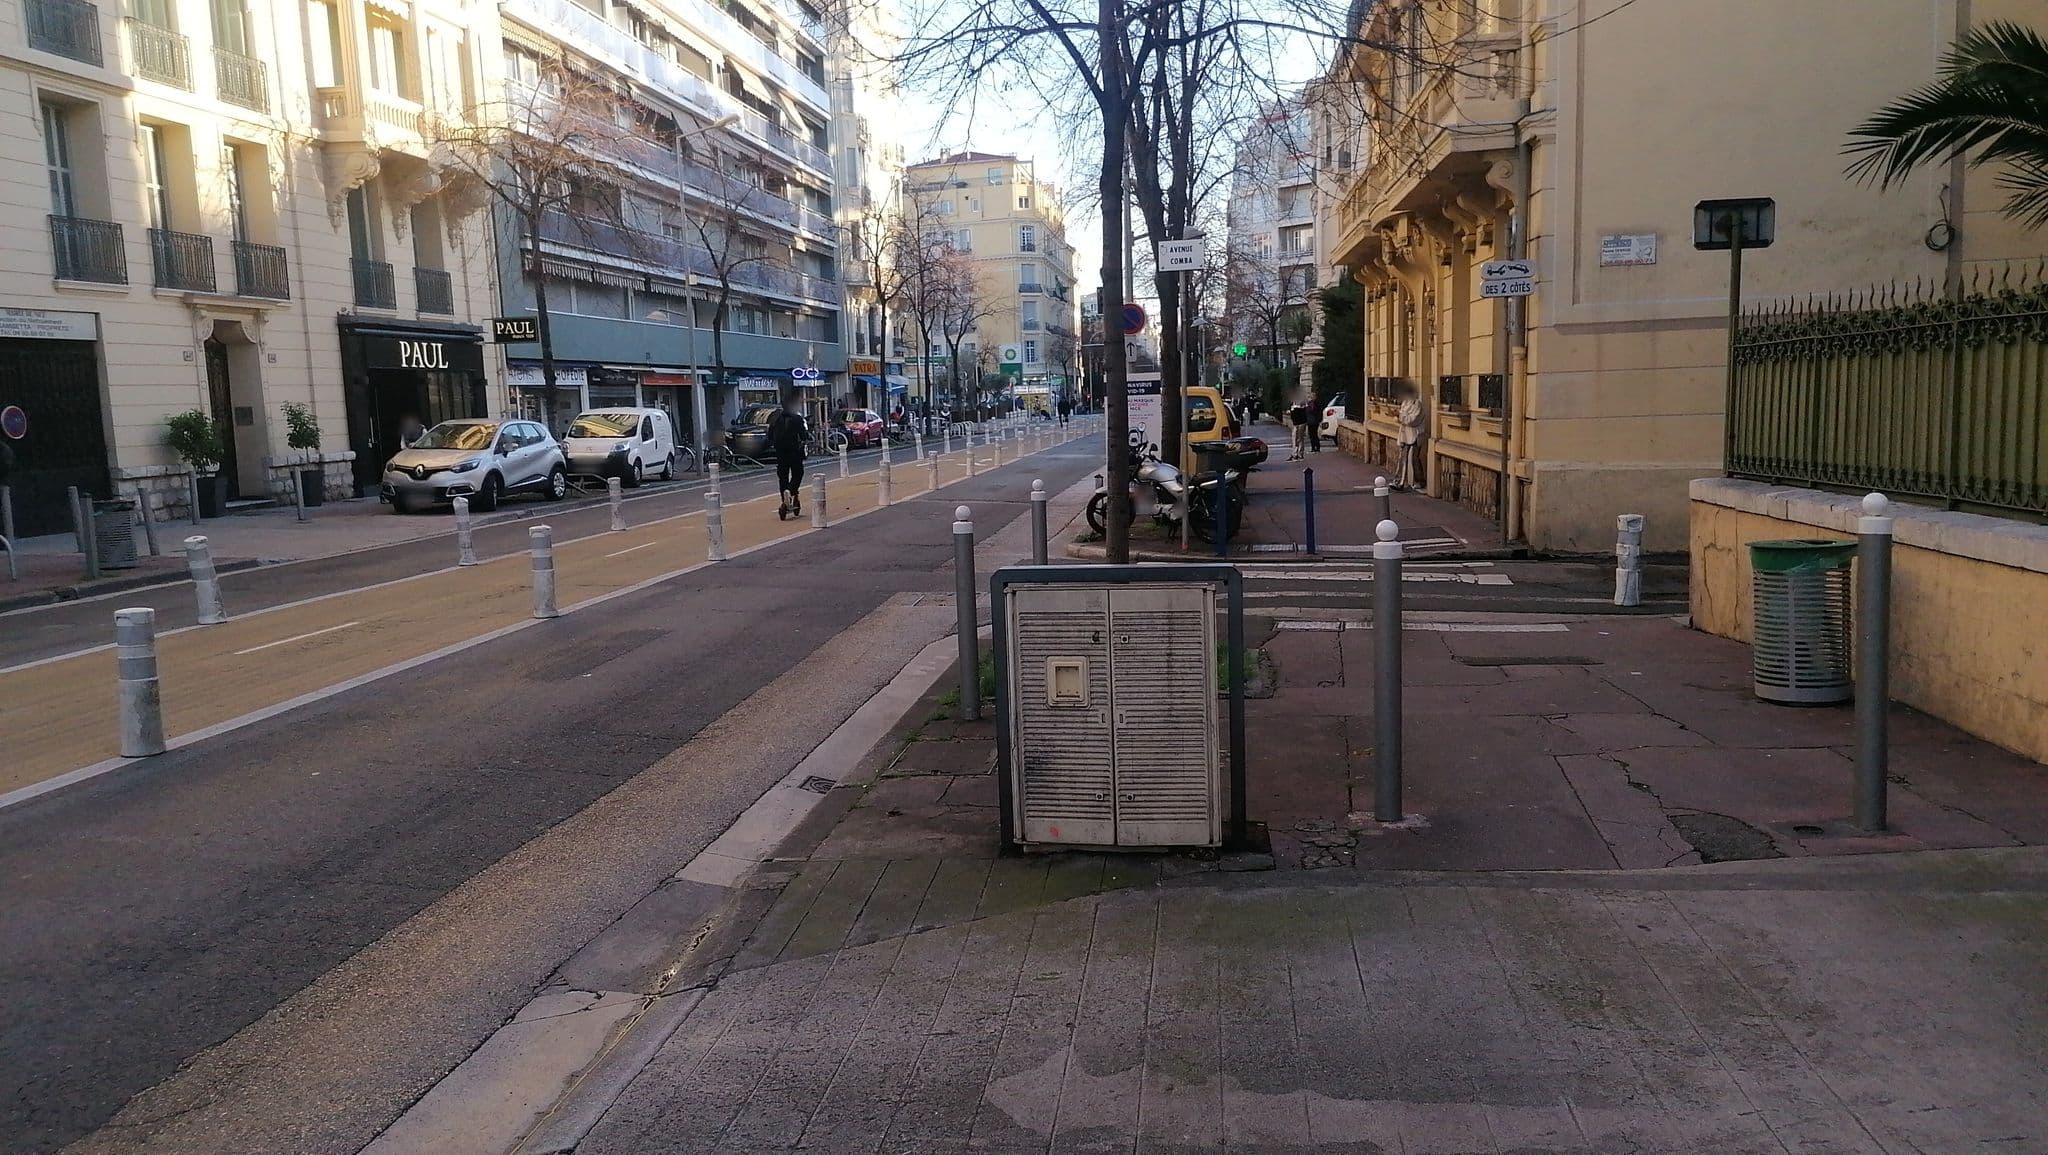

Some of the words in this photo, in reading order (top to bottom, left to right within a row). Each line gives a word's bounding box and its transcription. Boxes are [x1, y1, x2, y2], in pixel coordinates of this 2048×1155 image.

[1169, 245, 1193, 253] AVENUE
[1170, 256, 1193, 265] COMBA
[1485, 284, 1499, 295] DES
[1501, 281, 1507, 294] 2
[1509, 280, 1531, 293] CÔTÉS
[495, 321, 535, 335] PAUL
[399, 340, 449, 369] PAUL
